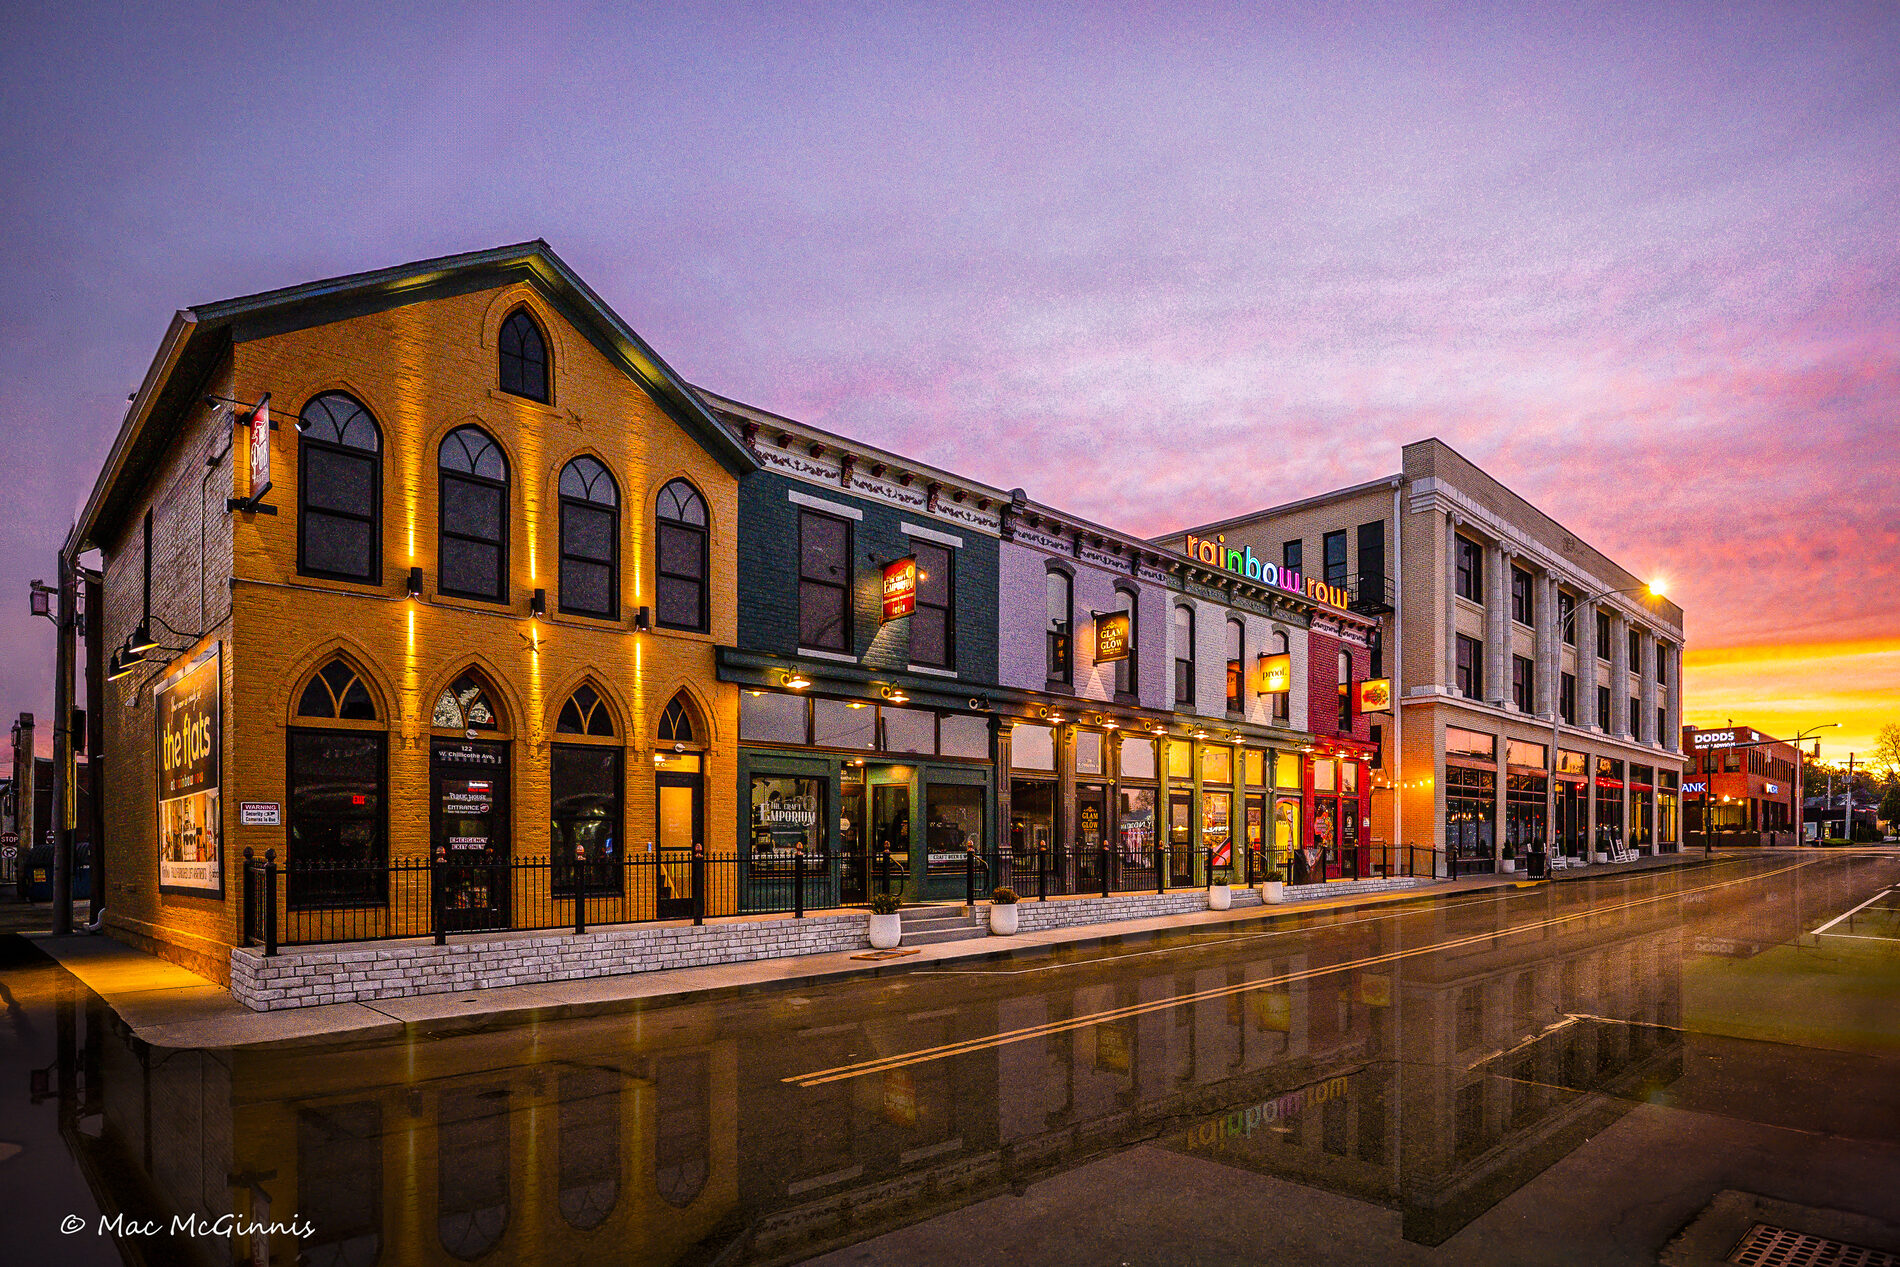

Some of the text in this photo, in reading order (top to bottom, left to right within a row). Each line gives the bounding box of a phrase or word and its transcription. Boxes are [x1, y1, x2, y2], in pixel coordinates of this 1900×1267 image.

[1187, 534, 1348, 610] rainbow row
[1101, 628, 1123, 639] GLAM
[1101, 639, 1124, 650] GLOW
[163, 711, 210, 771] the flats
[1694, 731, 1735, 743] DODDS
[448, 751, 480, 759] Chillicothe
[1681, 782, 1707, 793] ANK
[760, 803, 816, 827] EMPORIUM
[1082, 812, 1099, 820] GLAM
[1082, 821, 1099, 829] GLOW
